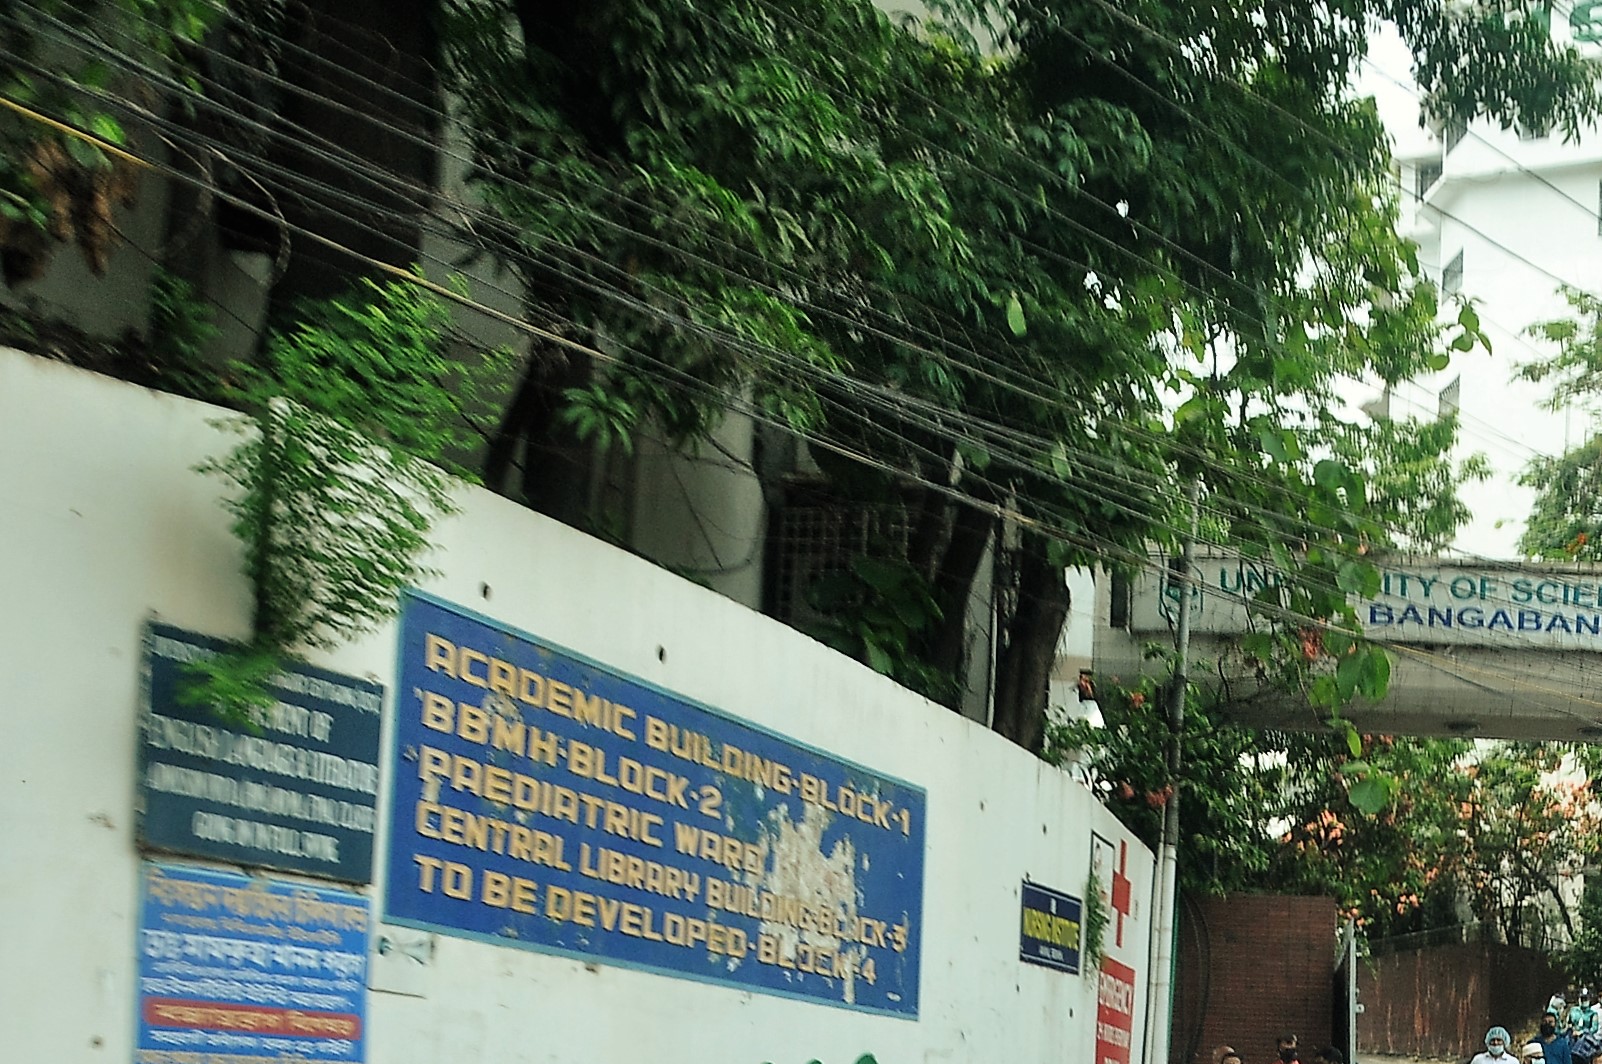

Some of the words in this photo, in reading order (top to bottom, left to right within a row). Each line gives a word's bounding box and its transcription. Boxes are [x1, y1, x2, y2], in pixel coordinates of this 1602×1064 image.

[1450, 575, 1497, 601] OF
[424, 632, 637, 741] ACADEMIC
[415, 799, 572, 873] CENTRAL
[579, 841, 700, 904] LIBRARY
[417, 744, 665, 848] PAEDIATRIC
[673, 820, 765, 877] WARD
[413, 853, 474, 902] TO
[481, 868, 538, 915] BE
